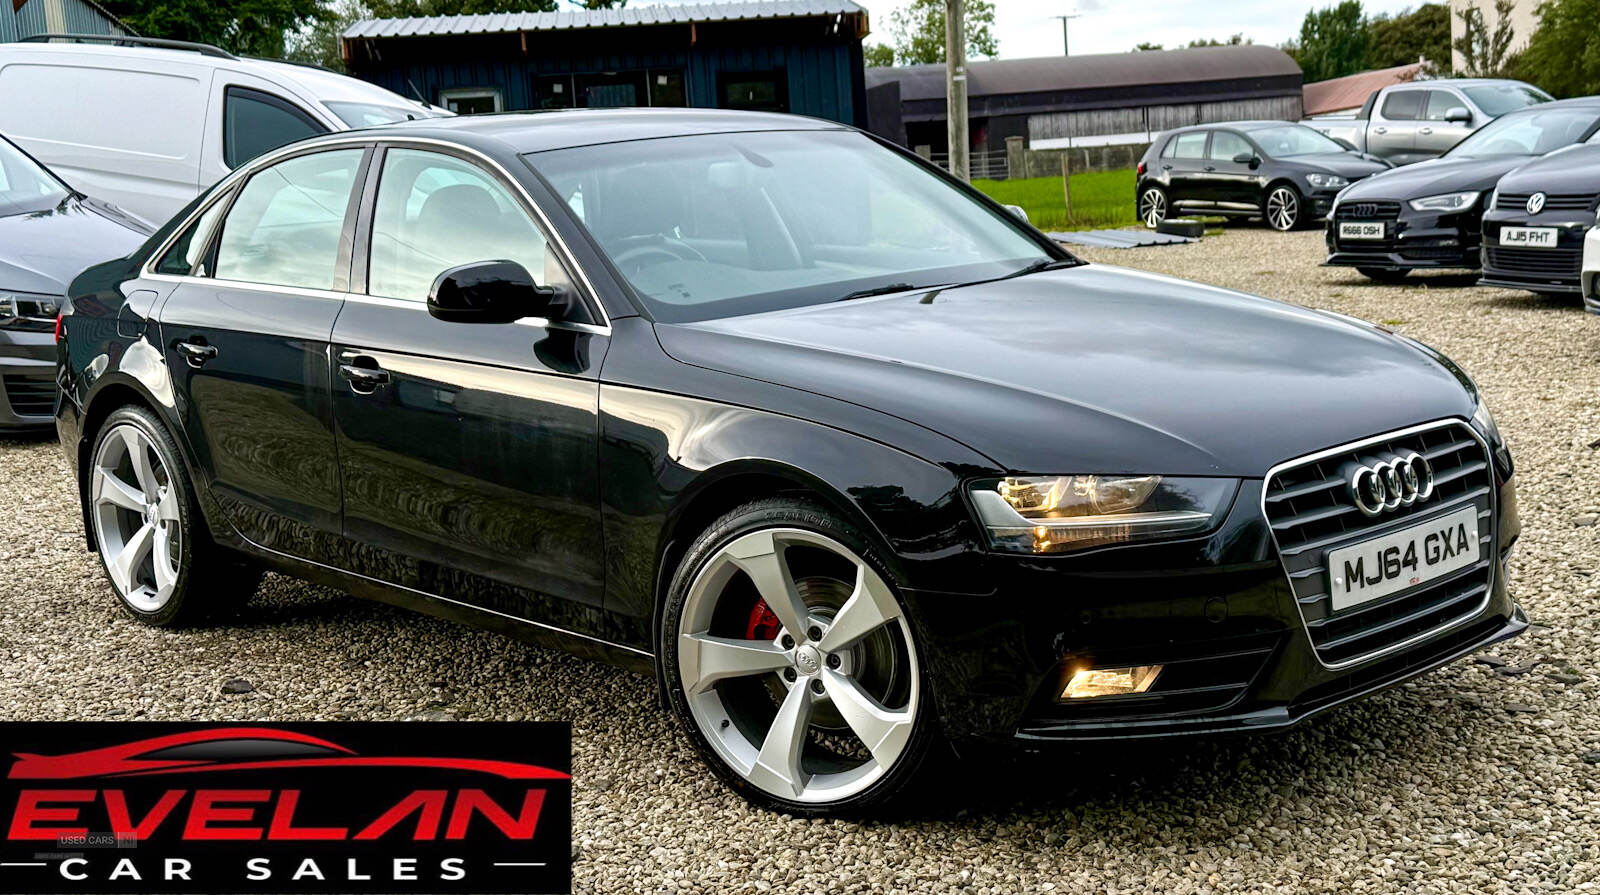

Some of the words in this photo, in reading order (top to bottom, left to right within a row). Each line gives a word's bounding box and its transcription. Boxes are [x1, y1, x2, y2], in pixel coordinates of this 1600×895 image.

[1506, 230, 1527, 242] AJ15
[1529, 231, 1550, 243] FHT
[1344, 539, 1418, 593] MJ64
[1424, 522, 1470, 567] GXA
